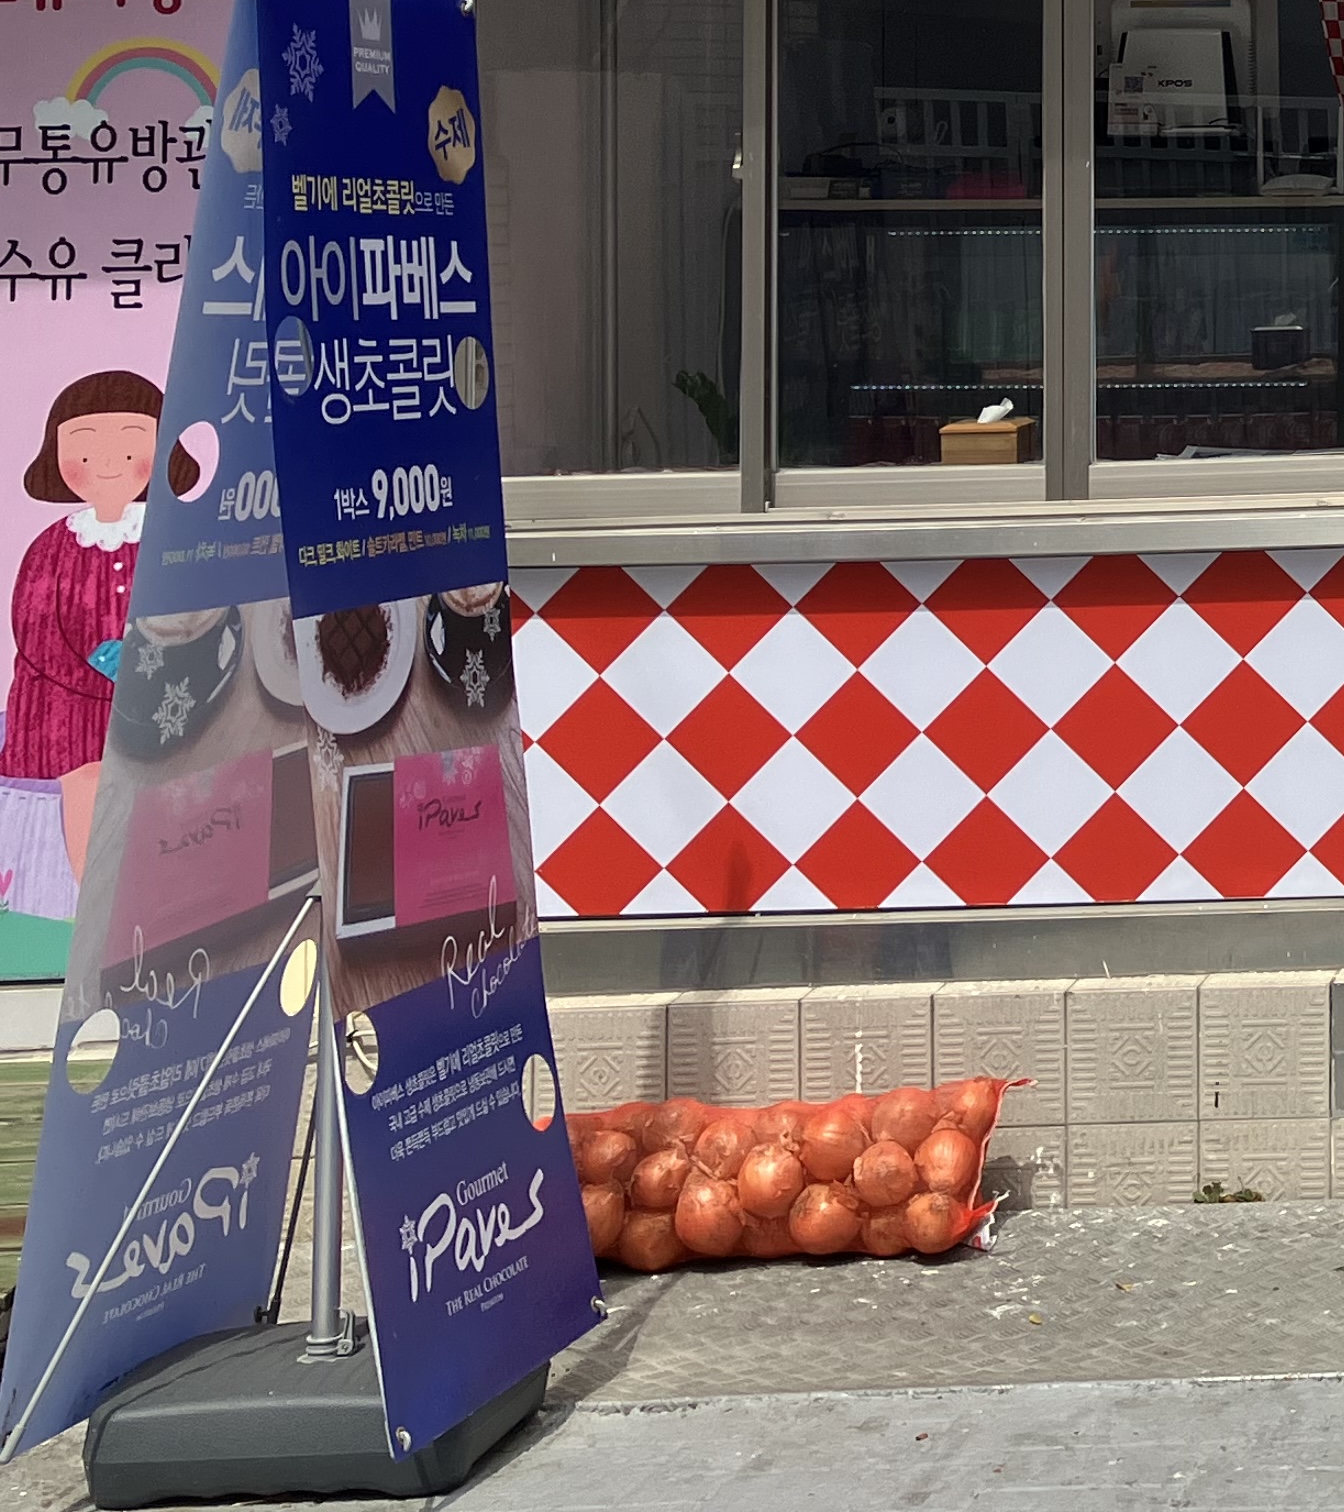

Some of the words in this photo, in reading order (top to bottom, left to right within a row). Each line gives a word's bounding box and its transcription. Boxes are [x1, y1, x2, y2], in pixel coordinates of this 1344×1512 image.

[353, 47, 391, 61] PREMIUM
[355, 61, 390, 75] QUALITY
[435, 108, 470, 160] 수제
[291, 174, 338, 212] 벨기에
[341, 177, 433, 216] 리얼초콜릿으로
[434, 192, 454, 216] 만든
[280, 235, 477, 321] 아이파베스
[314, 335, 456, 425] 생초콜릿
[334, 488, 370, 521] 1박스
[371, 464, 453, 521] 9,000원
[441, 875, 505, 1010] Real
[455, 1161, 508, 1206] Gourmet
[399, 1168, 545, 1303] iPaves
[445, 1296, 463, 1318] THE
[462, 1282, 484, 1307] REAL
[483, 1255, 530, 1293] CHOCOLATE
